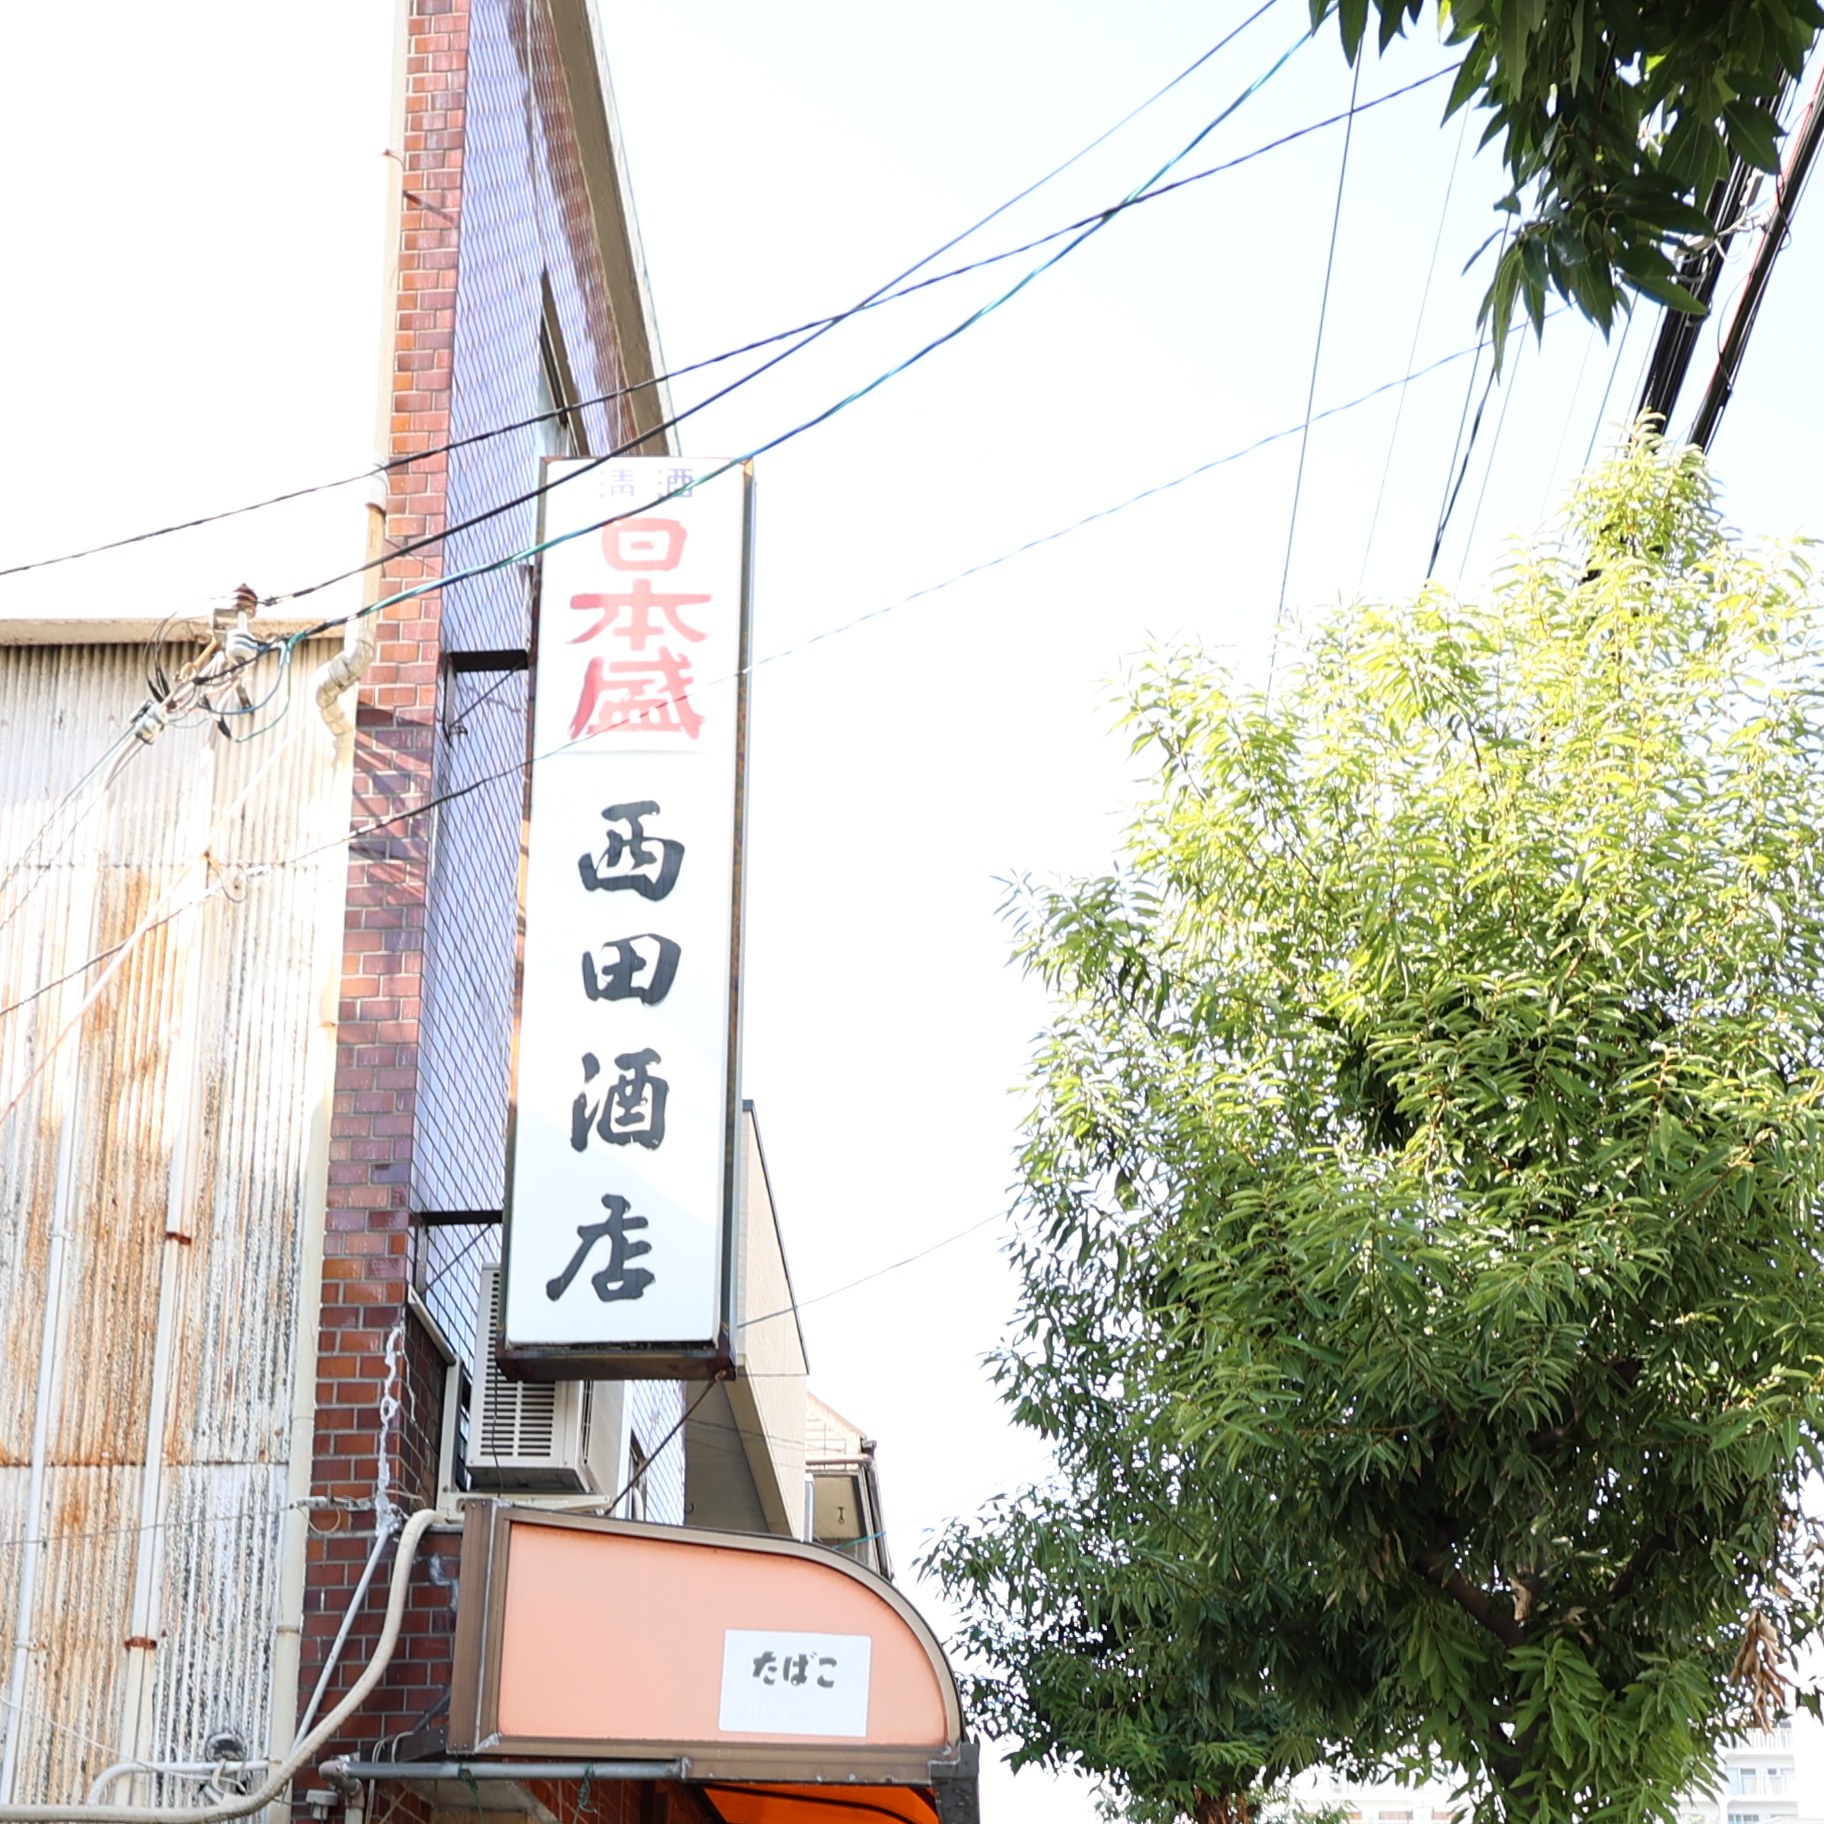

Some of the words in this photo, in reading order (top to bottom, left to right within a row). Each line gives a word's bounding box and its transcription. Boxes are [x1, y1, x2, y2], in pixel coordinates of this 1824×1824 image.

[566, 516, 712, 740] 日本盛
[546, 799, 686, 1304] 西田酒店
[752, 1650, 837, 1689] たばこ
